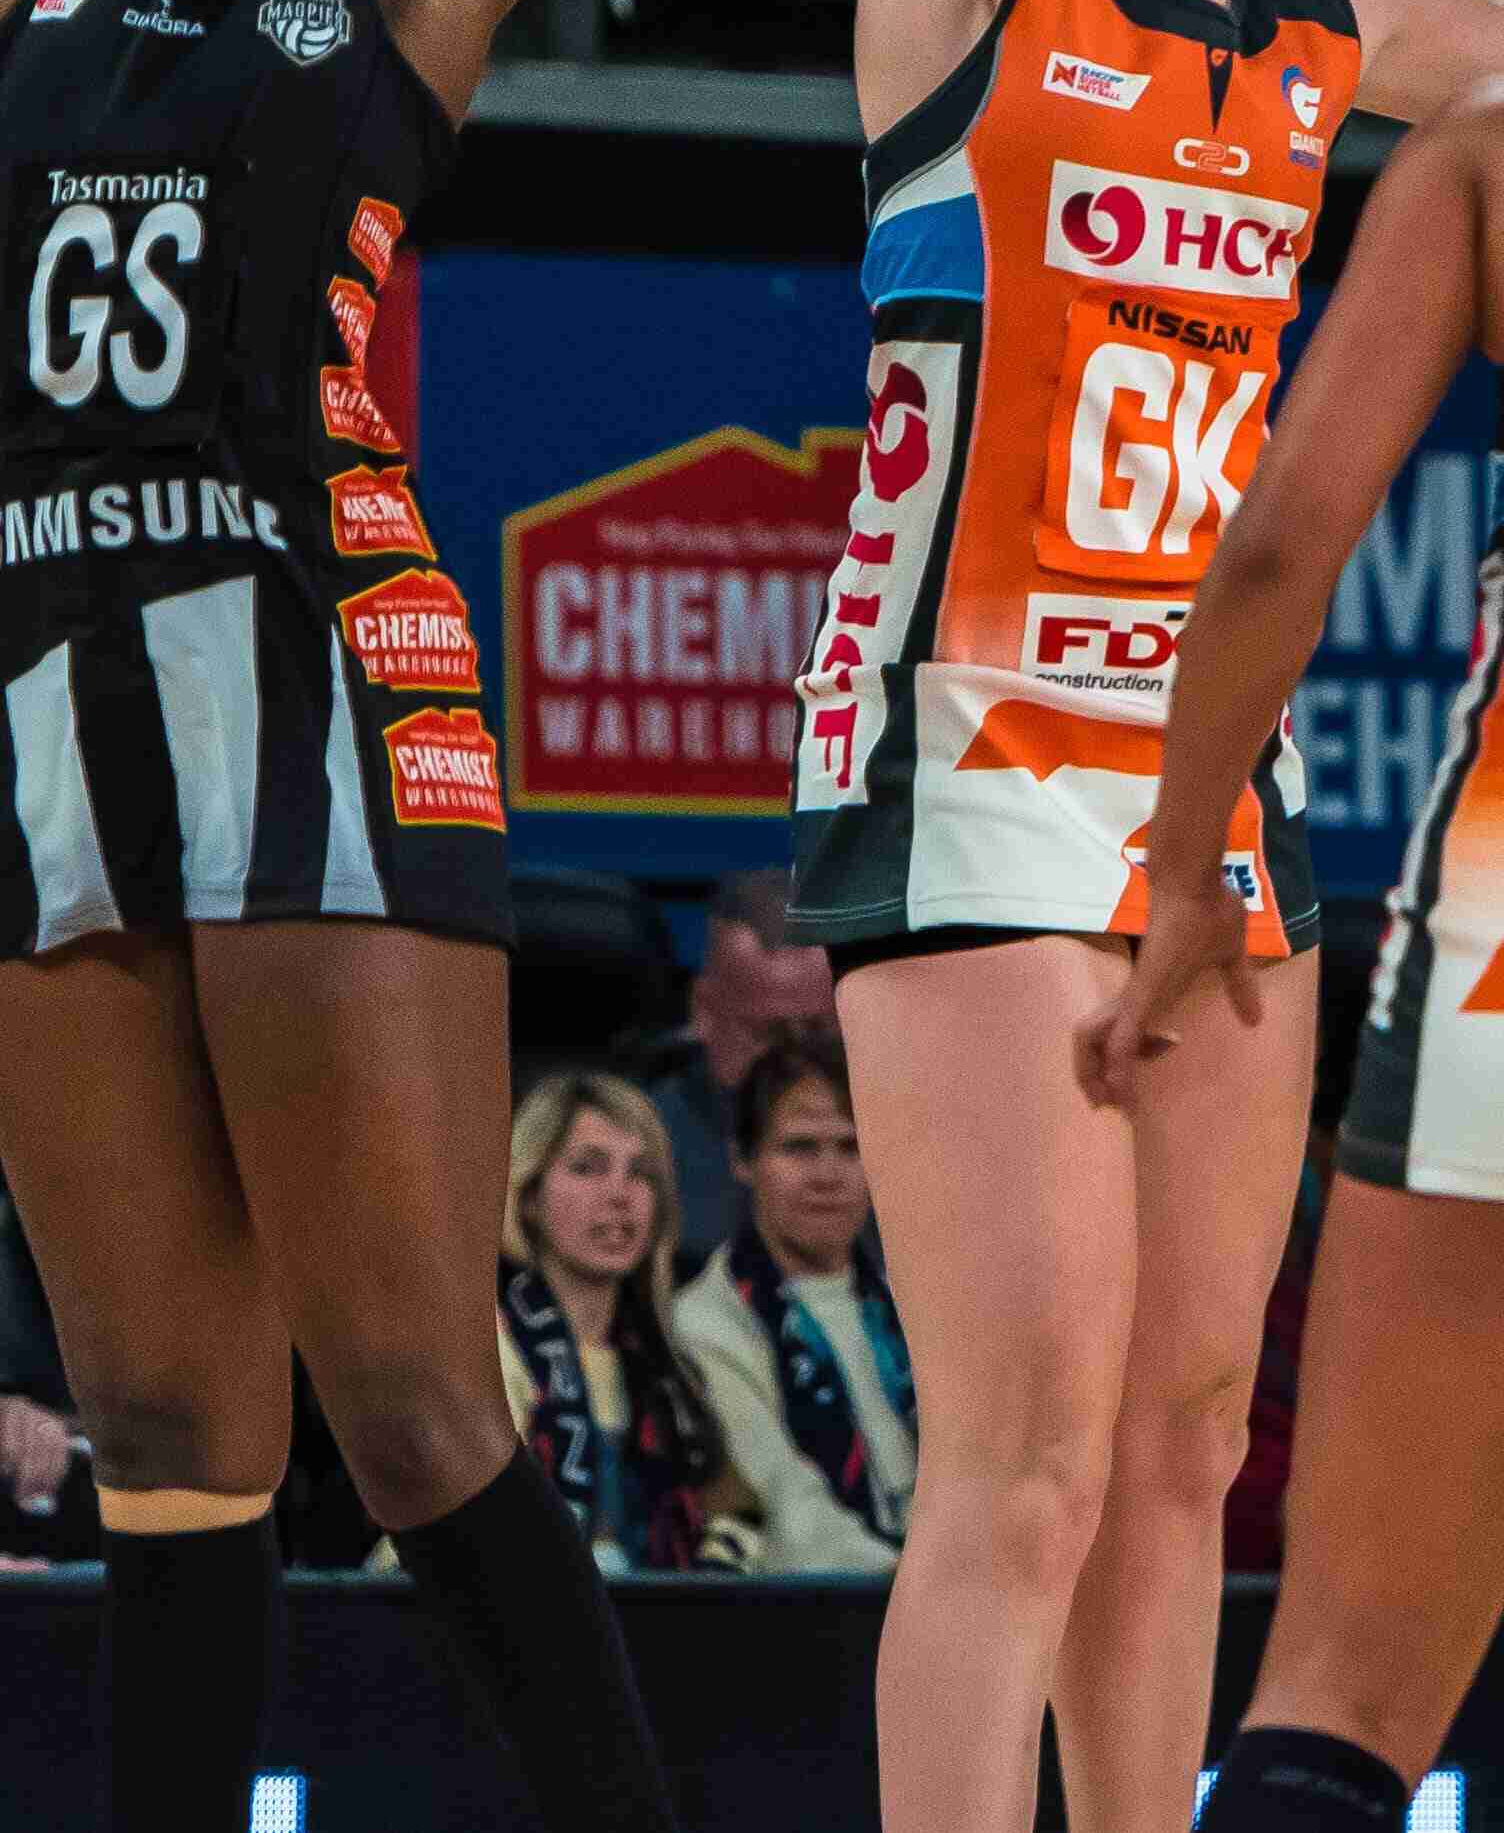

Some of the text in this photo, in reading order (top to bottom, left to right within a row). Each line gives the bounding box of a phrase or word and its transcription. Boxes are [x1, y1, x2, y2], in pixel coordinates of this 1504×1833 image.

[48, 167, 208, 205] Tasmania
[28, 202, 203, 407] GS
[1107, 298, 1253, 356] NISSAN
[1065, 341, 1268, 555] GK
[1037, 615, 1178, 670] FD
